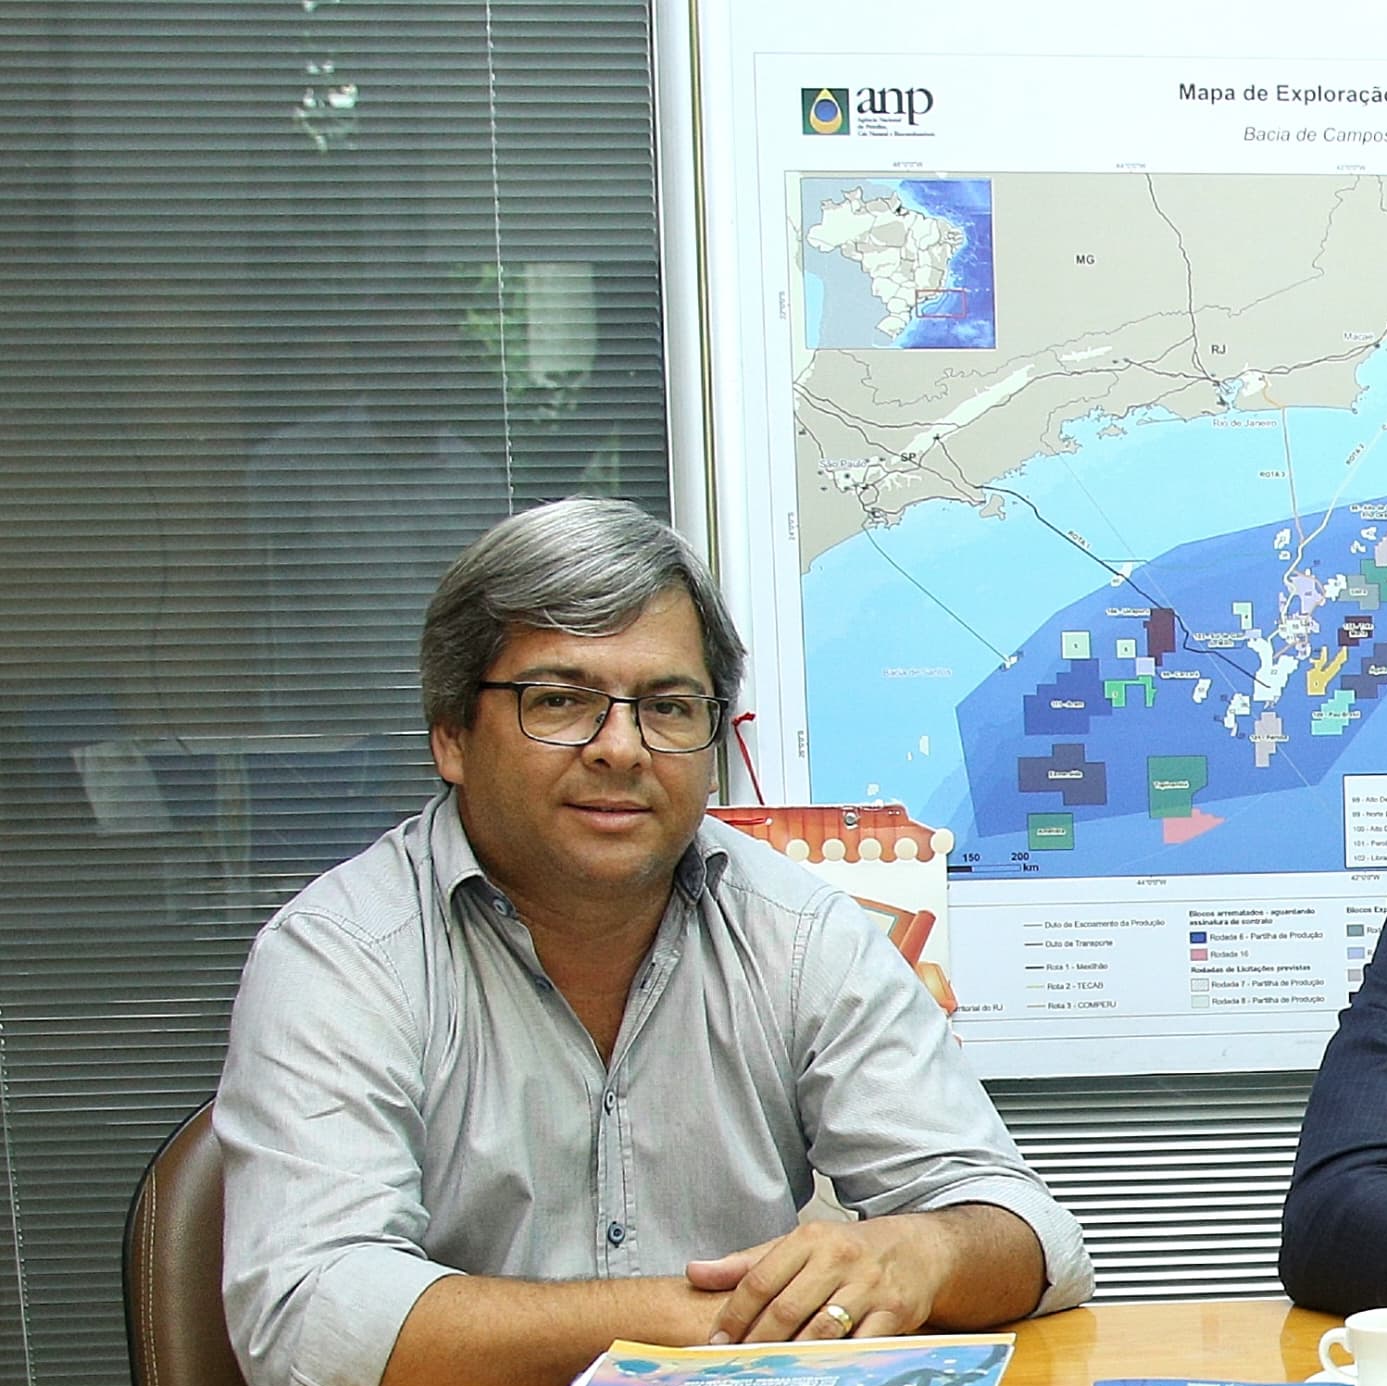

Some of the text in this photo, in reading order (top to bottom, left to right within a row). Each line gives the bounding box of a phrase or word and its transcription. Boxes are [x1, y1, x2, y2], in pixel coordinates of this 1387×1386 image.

[1179, 83, 1235, 105] Mapa
[1244, 84, 1268, 101] de
[856, 87, 934, 126] anp
[1244, 126, 1290, 142] Bacia
[1296, 127, 1317, 142] de
[1076, 255, 1095, 265] MG
[1211, 344, 1226, 355] RJ
[900, 453, 916, 462] SP
[963, 853, 980, 862] 150
[1011, 852, 1030, 862] 200
[1023, 863, 1039, 873] km
